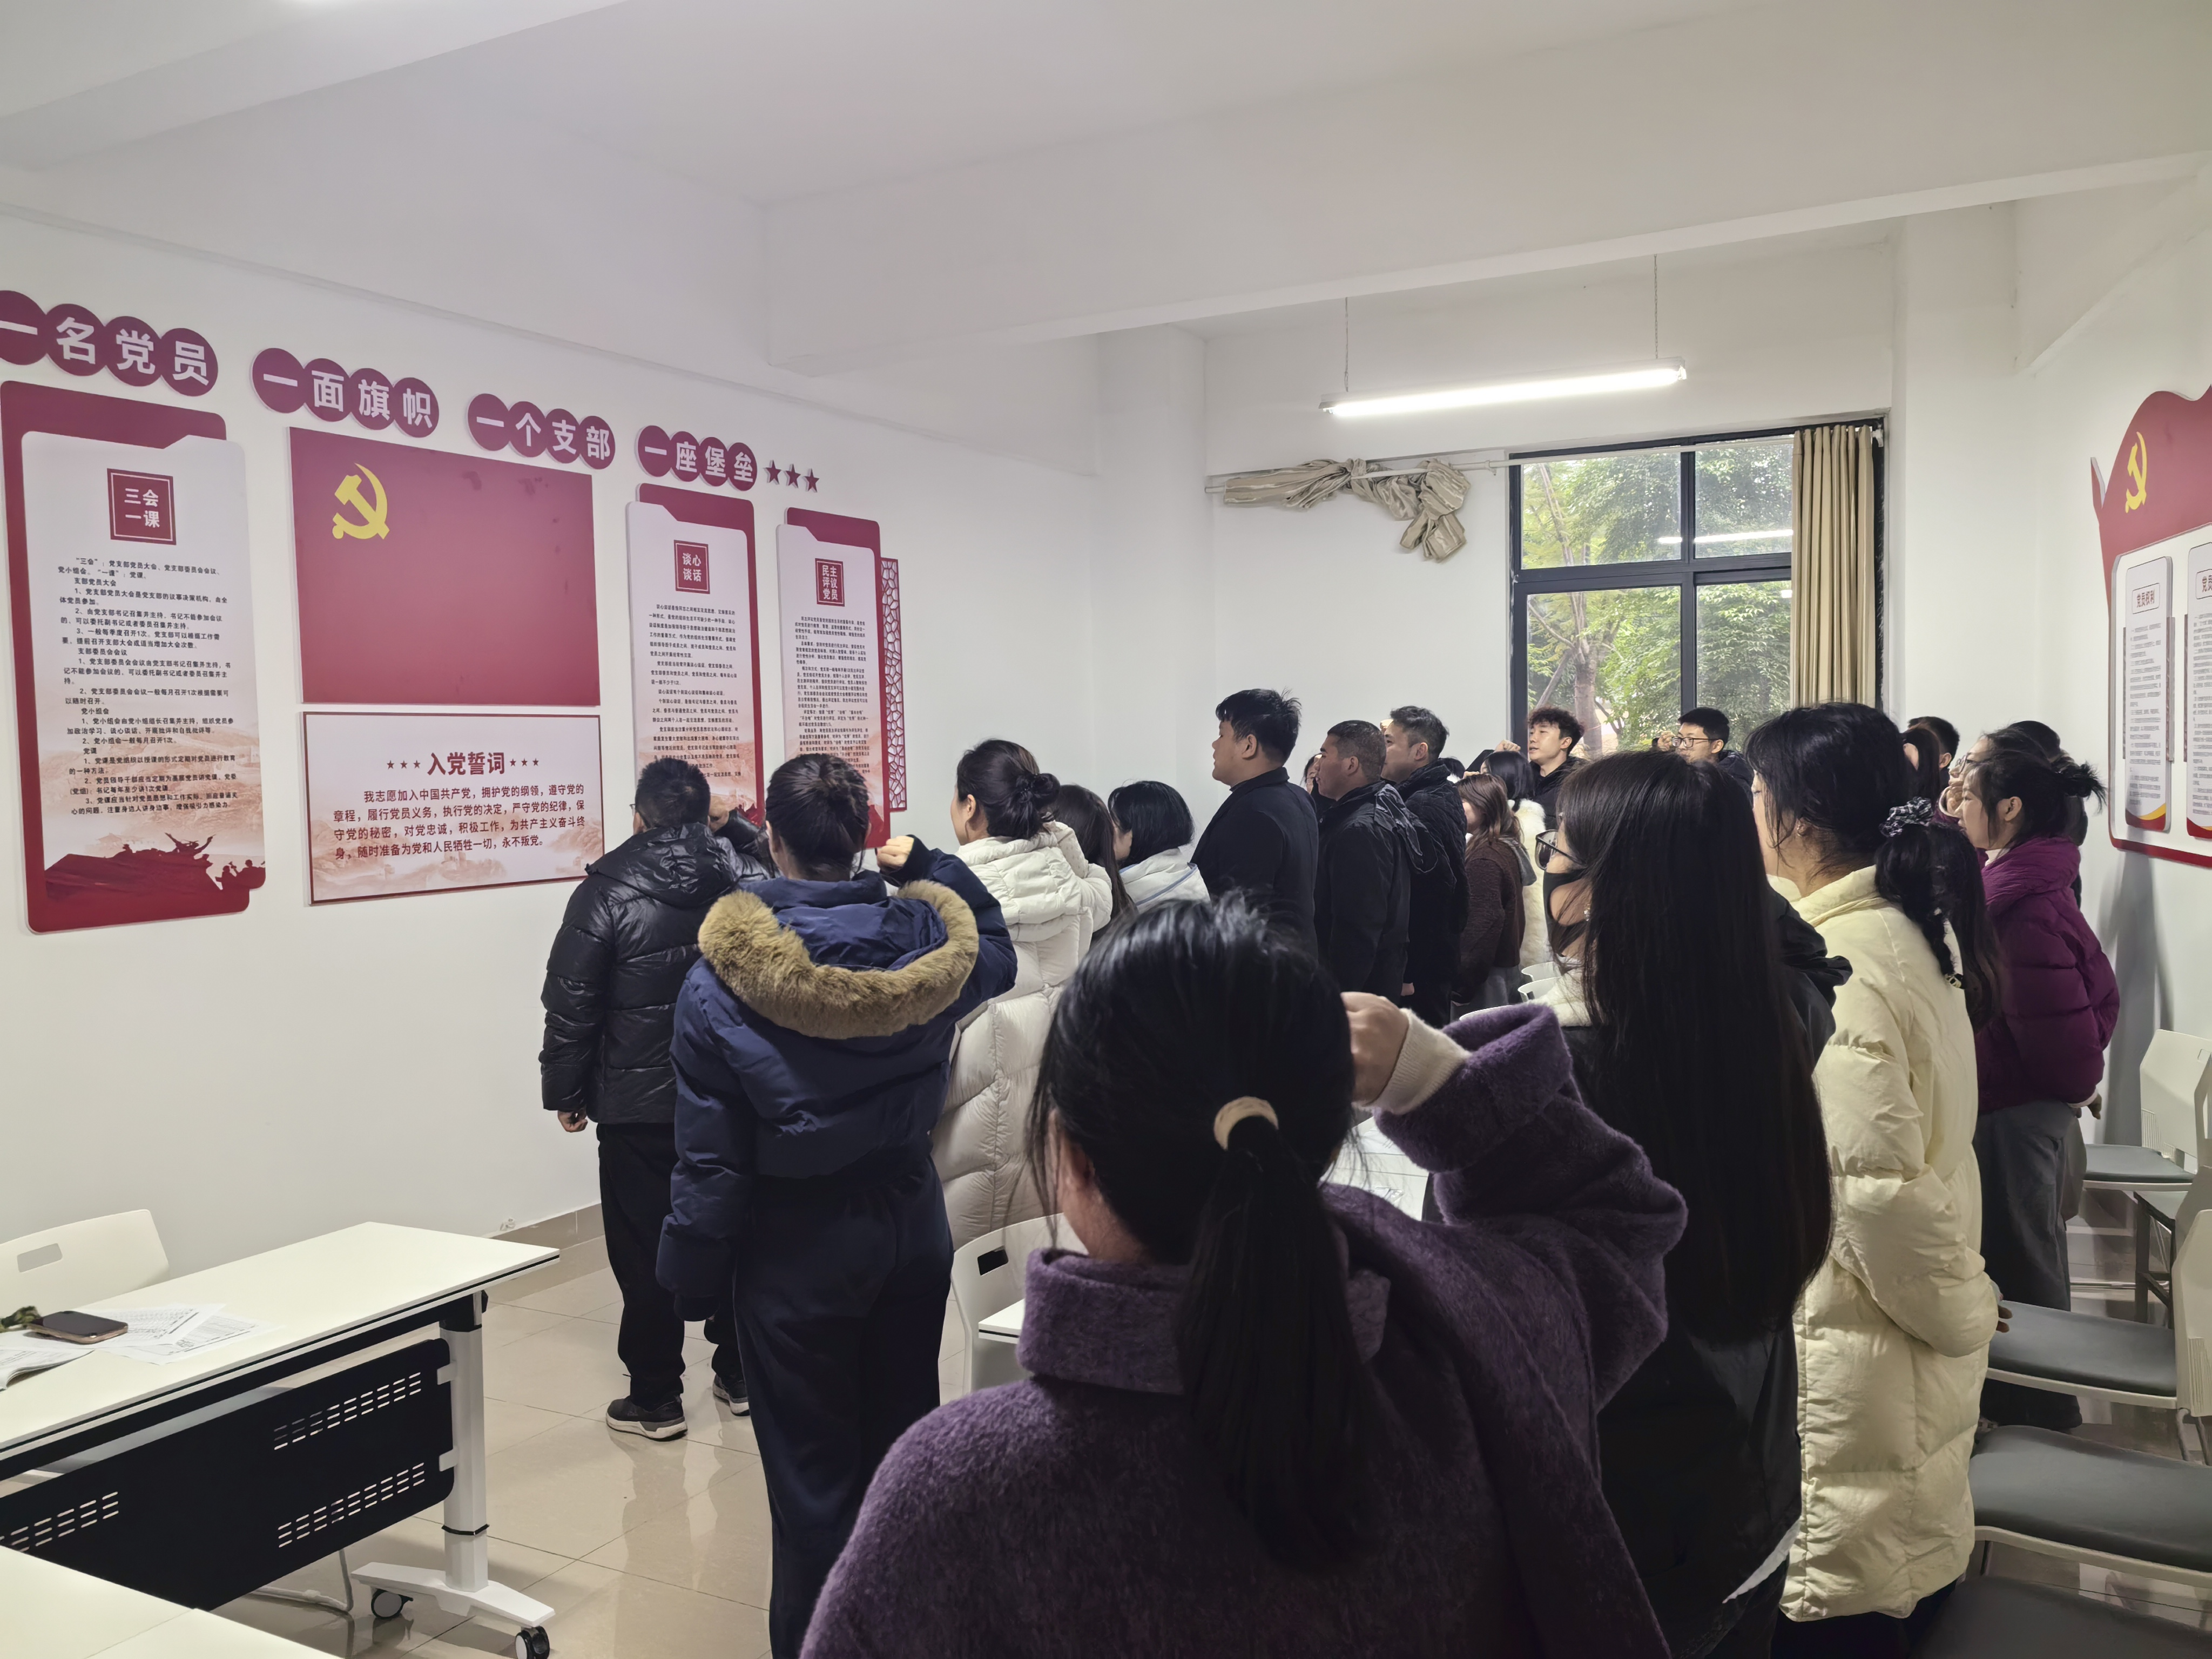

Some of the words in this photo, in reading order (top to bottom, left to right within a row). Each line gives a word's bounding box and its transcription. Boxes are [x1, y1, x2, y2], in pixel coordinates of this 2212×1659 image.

[0, 316, 210, 386] 一名党员
[263, 369, 433, 429] 一面旗帜
[476, 413, 611, 461] 一个支部
[644, 441, 754, 483] 一座堡垒
[124, 488, 159, 507] 三会
[125, 510, 160, 528] 一课
[682, 552, 702, 567] 谈心
[683, 568, 702, 582] 谈话
[822, 564, 838, 577] 民主
[74, 577, 117, 587] 支部党员大会
[822, 576, 838, 589] 评议
[822, 588, 839, 601] 党员
[78, 648, 128, 656] 支部委员会会议
[427, 751, 505, 776] 入党誓词
[363, 784, 584, 804] 我志愿加入中国共产党，拥护党的纲领，遵守党的
[333, 800, 585, 822] 章程，履行党员义务，执行党的决定，严守党的纪律，保
[333, 815, 585, 841] 守党的秘密，对党忠诚，积极工作，为共产主义奋斗终
[334, 834, 543, 860] 身，随时准备为党和人民牺牲一切，永不叛党。
